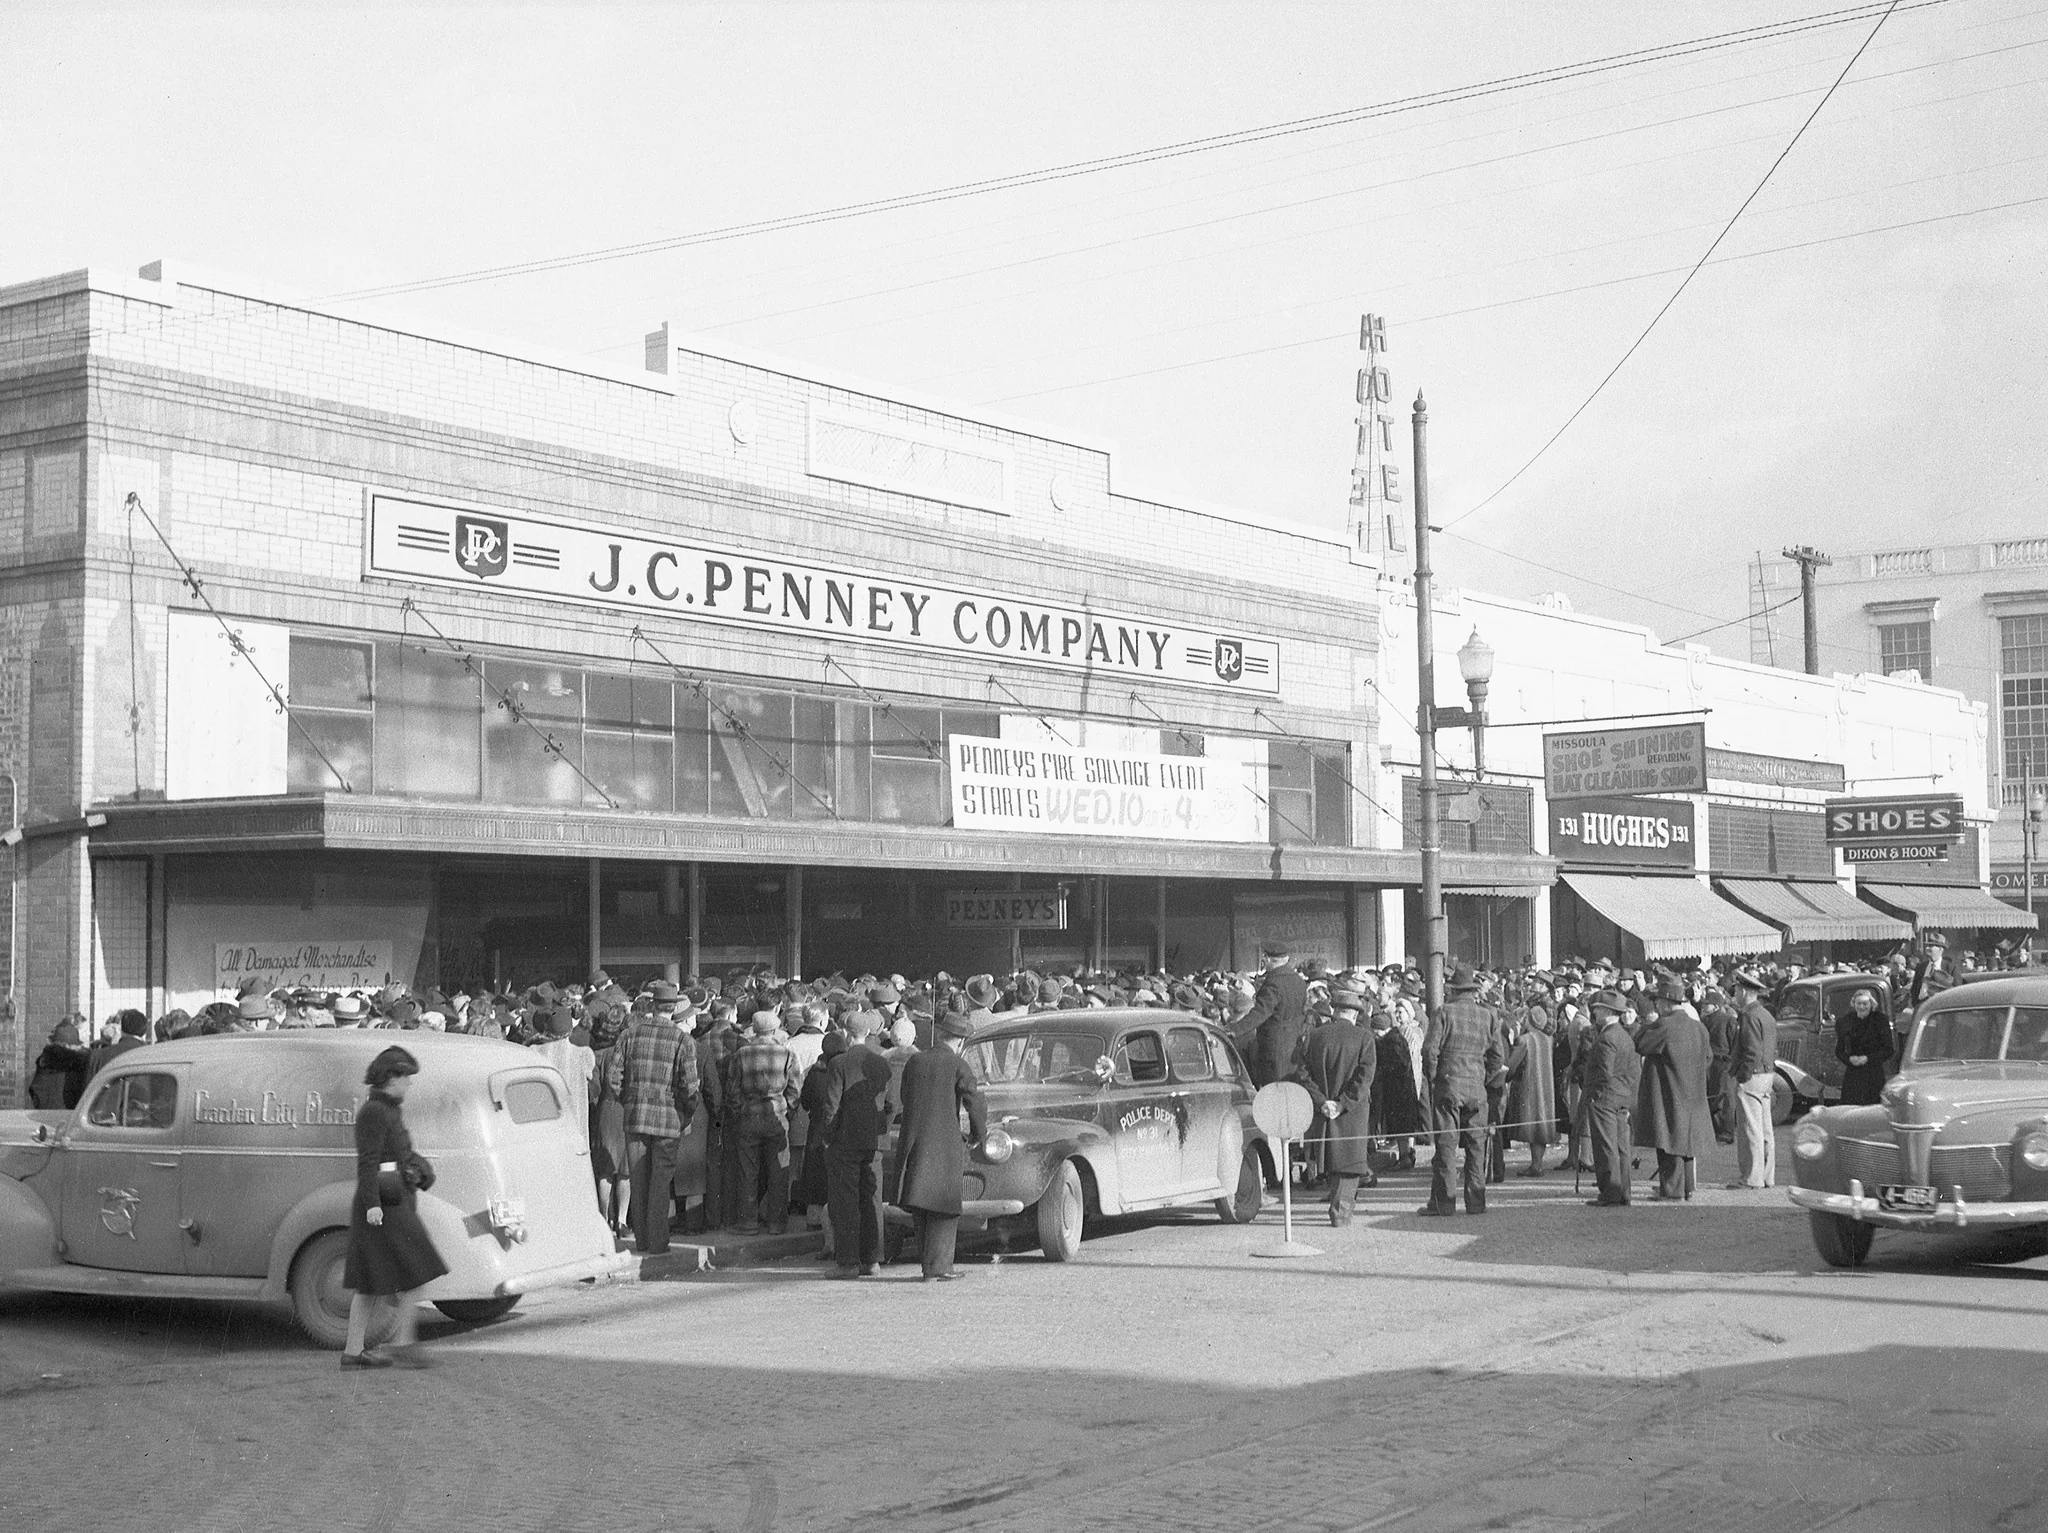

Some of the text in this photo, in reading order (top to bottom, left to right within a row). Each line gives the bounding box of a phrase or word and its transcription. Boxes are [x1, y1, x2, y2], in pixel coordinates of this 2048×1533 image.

[1370, 313, 1407, 552] HOTEL
[953, 600, 1171, 671] COMPANY
[1551, 736, 1607, 750] MISSOULA
[1552, 729, 1695, 774] SHOE SHINING
[1647, 752, 1691, 764] REPAIRING
[960, 743, 1207, 791] PENNEYS FIRE SALVAGE EVENT
[1552, 773, 1582, 793] HAT
[1584, 767, 1658, 791] CLEANING
[1661, 765, 1699, 788] SHOP
[962, 784, 1041, 819] STARTS
[1175, 795, 1192, 830] 4
[1832, 808, 1951, 832] SHOES
[1559, 812, 1690, 849] 131 HUGHES 131
[1848, 846, 1937, 861] DIXON & HOON
[1989, 873, 2048, 888] OME
[220, 944, 377, 975] All Damaged Merchandise
[194, 1089, 256, 1125] Garden
[262, 1090, 298, 1129] City
[1120, 1106, 1151, 1132] POLICE
